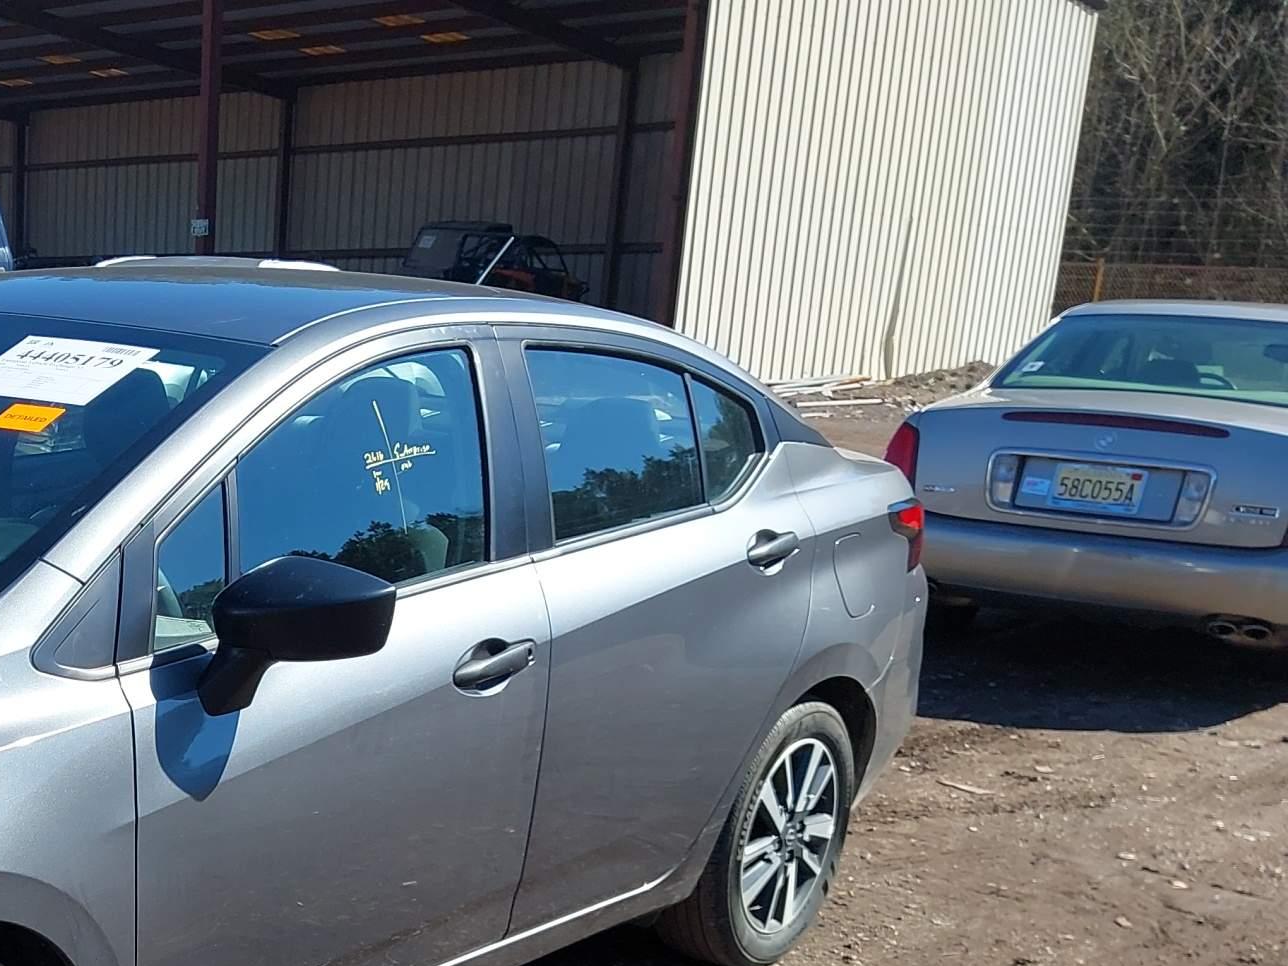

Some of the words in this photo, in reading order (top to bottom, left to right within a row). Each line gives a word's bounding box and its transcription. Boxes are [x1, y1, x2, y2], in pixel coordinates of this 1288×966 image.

[15, 349, 124, 368] 44405179
[4, 413, 48, 422] DETAILED
[1056, 476, 1135, 506] 58C055A
